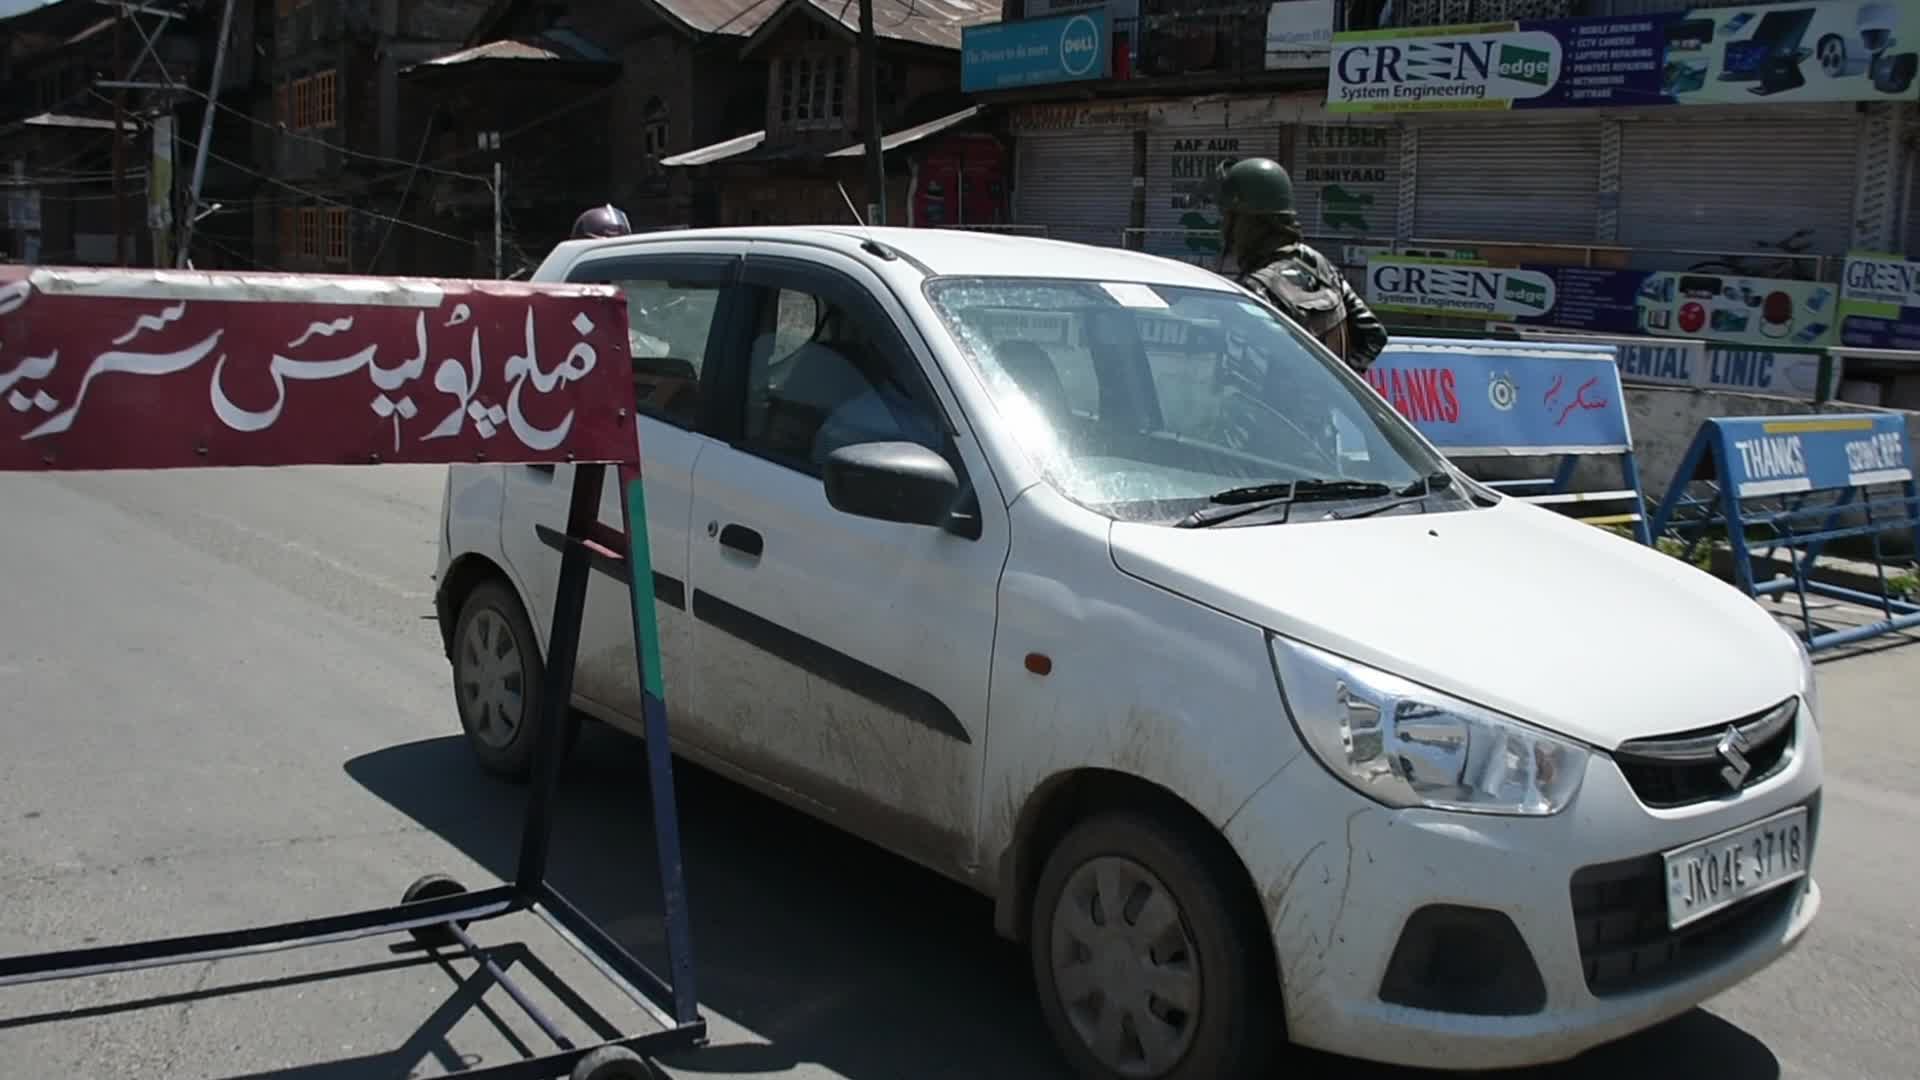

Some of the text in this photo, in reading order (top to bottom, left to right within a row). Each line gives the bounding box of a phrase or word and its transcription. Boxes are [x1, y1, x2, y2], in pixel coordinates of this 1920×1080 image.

[1065, 36, 1094, 53] DELL
[1337, 40, 1497, 85] GREEN
[1500, 58, 1549, 77] edge
[1341, 82, 1486, 99] System Engineering
[1174, 138, 1239, 152] AAP AUR
[1374, 265, 1503, 299] GREEN
[1847, 259, 1912, 292] GREEN
[1377, 292, 1496, 312] System Engineering
[1504, 287, 1547, 302] edge
[1617, 344, 1775, 388] DENTAL LINIC
[1365, 367, 1460, 424] HANKS
[1735, 435, 1806, 478] THANKS
[1753, 825, 1801, 880] 3718
